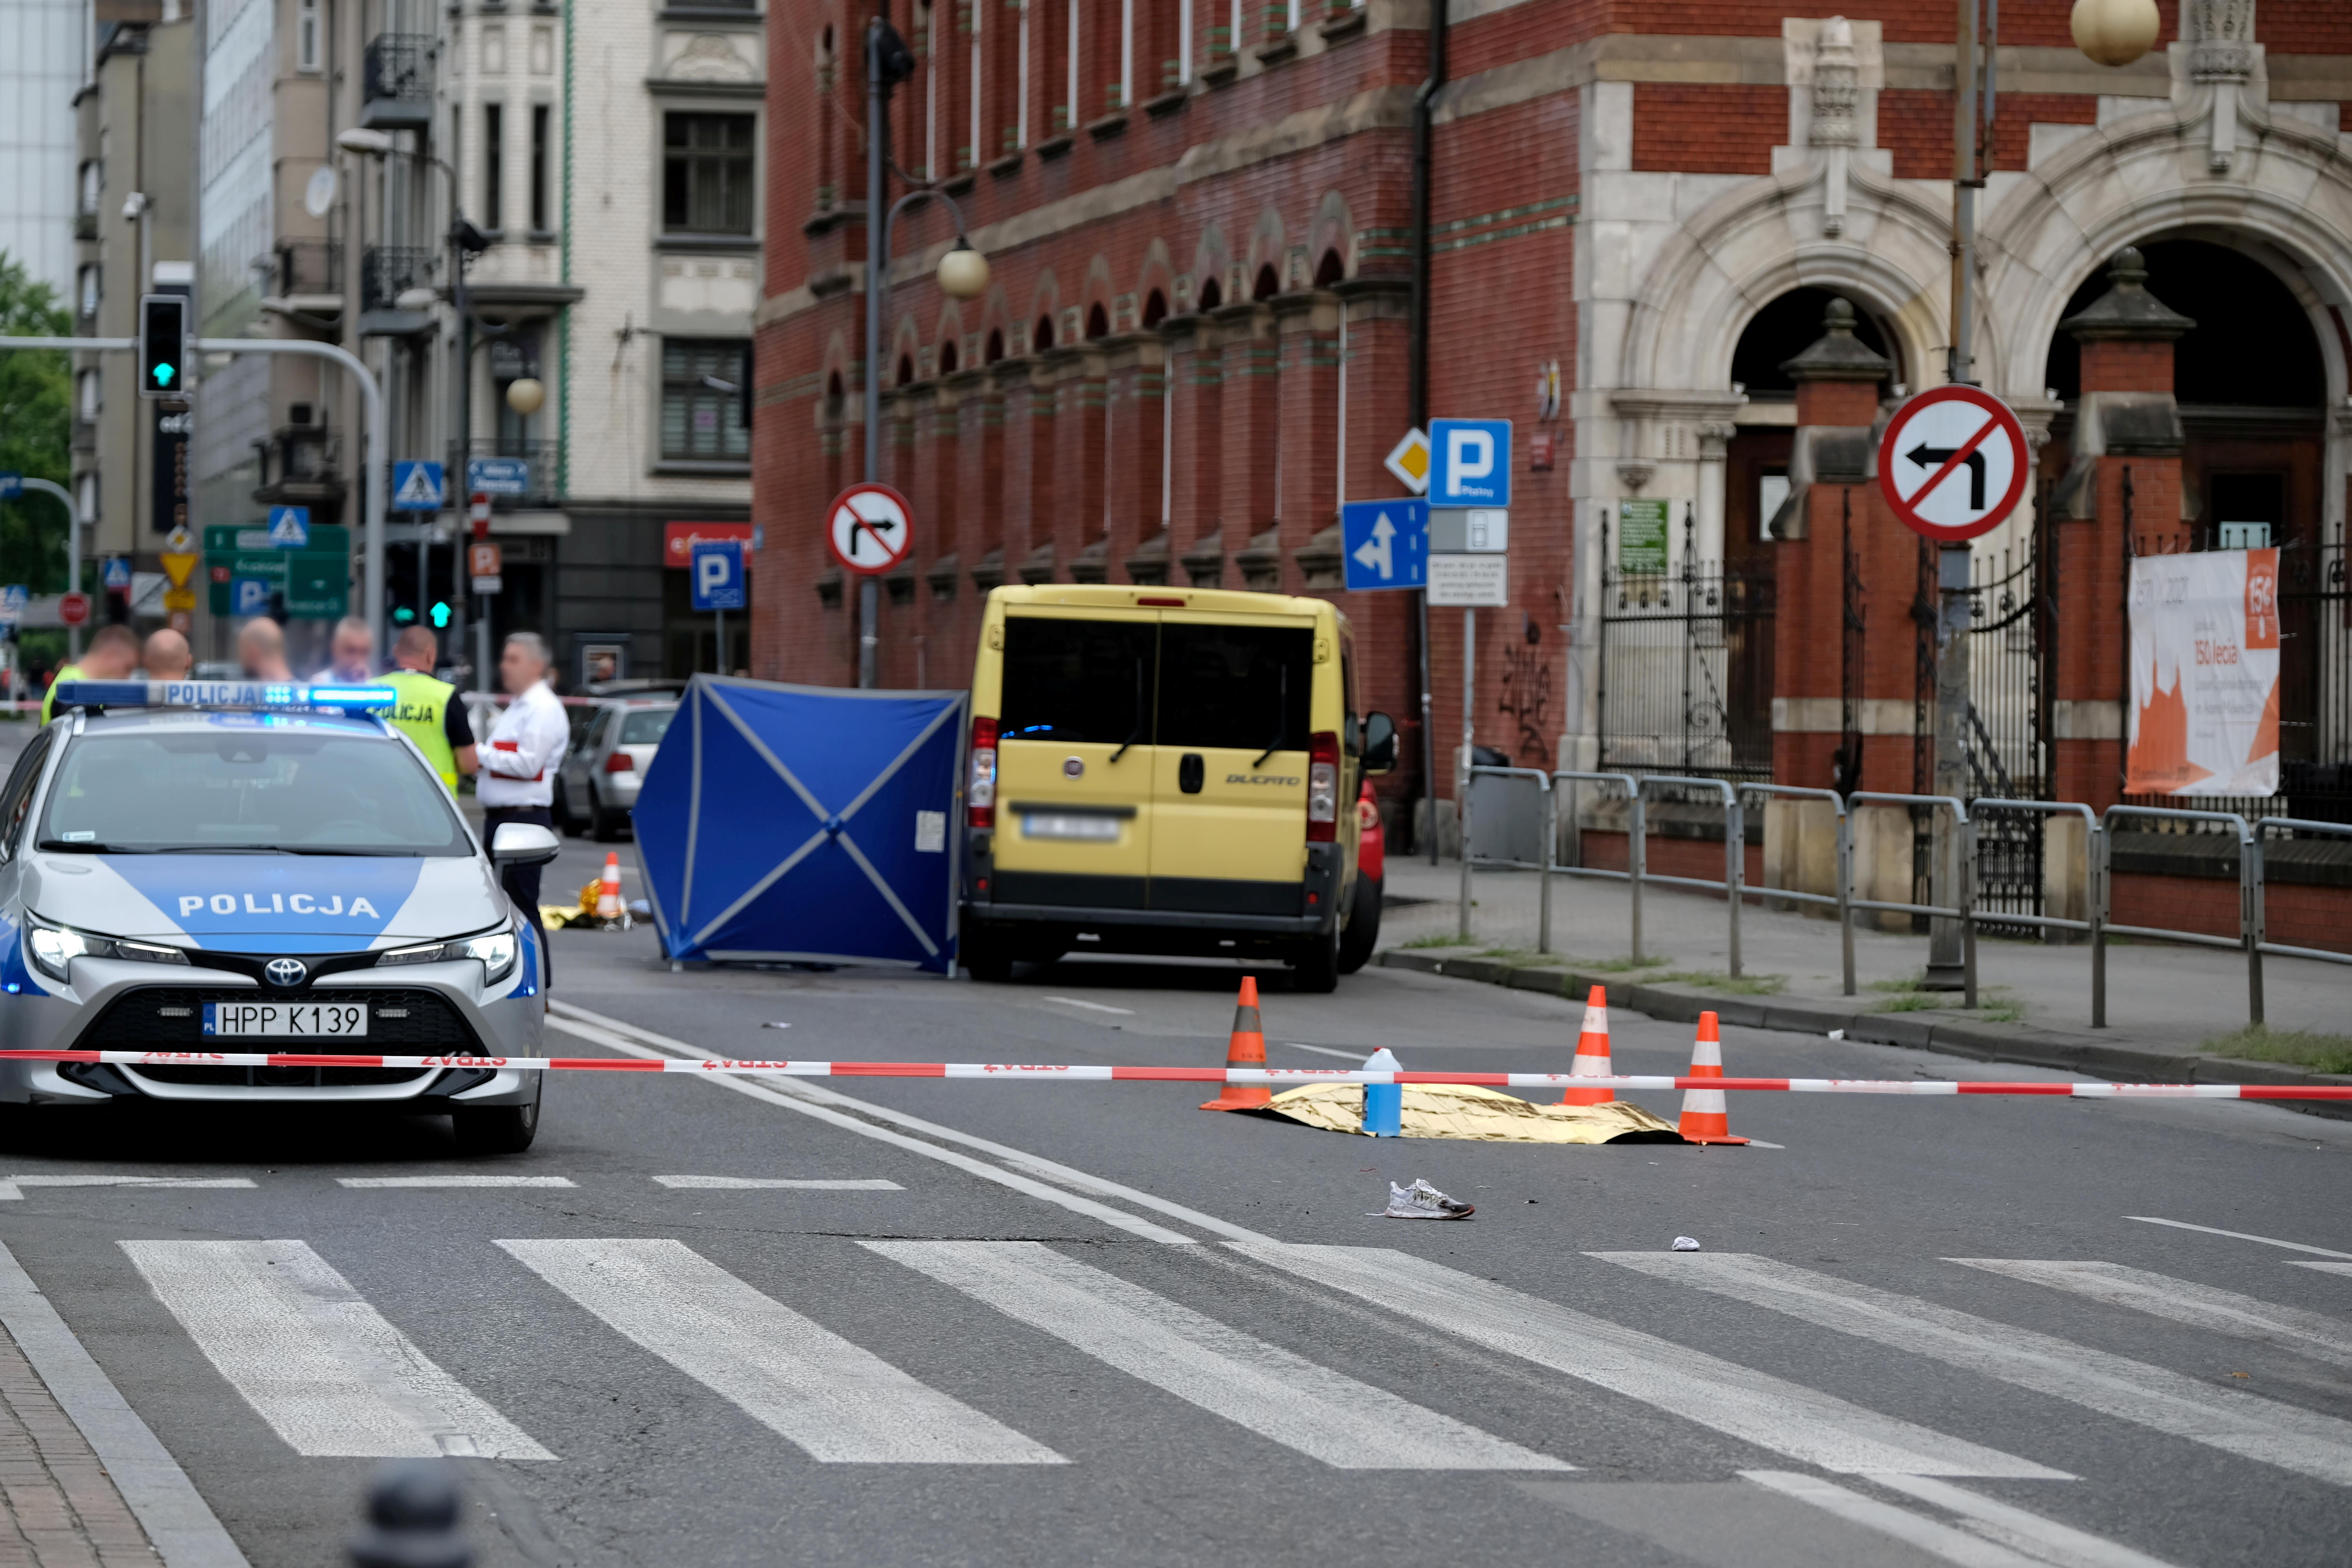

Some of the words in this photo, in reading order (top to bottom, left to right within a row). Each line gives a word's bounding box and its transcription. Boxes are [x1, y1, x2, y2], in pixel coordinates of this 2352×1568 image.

[1446, 429, 1494, 497] P
[698, 553, 730, 598] P
[2213, 638, 2238, 665] lecia
[168, 685, 254, 704] POLICJA
[376, 702, 433, 722] OLICJA
[1225, 774, 1301, 786] DUCATO
[178, 893, 380, 919] POLICJA
[204, 1022, 214, 1031] PL
[222, 1007, 277, 1033] HPP
[289, 1007, 359, 1033] K139
